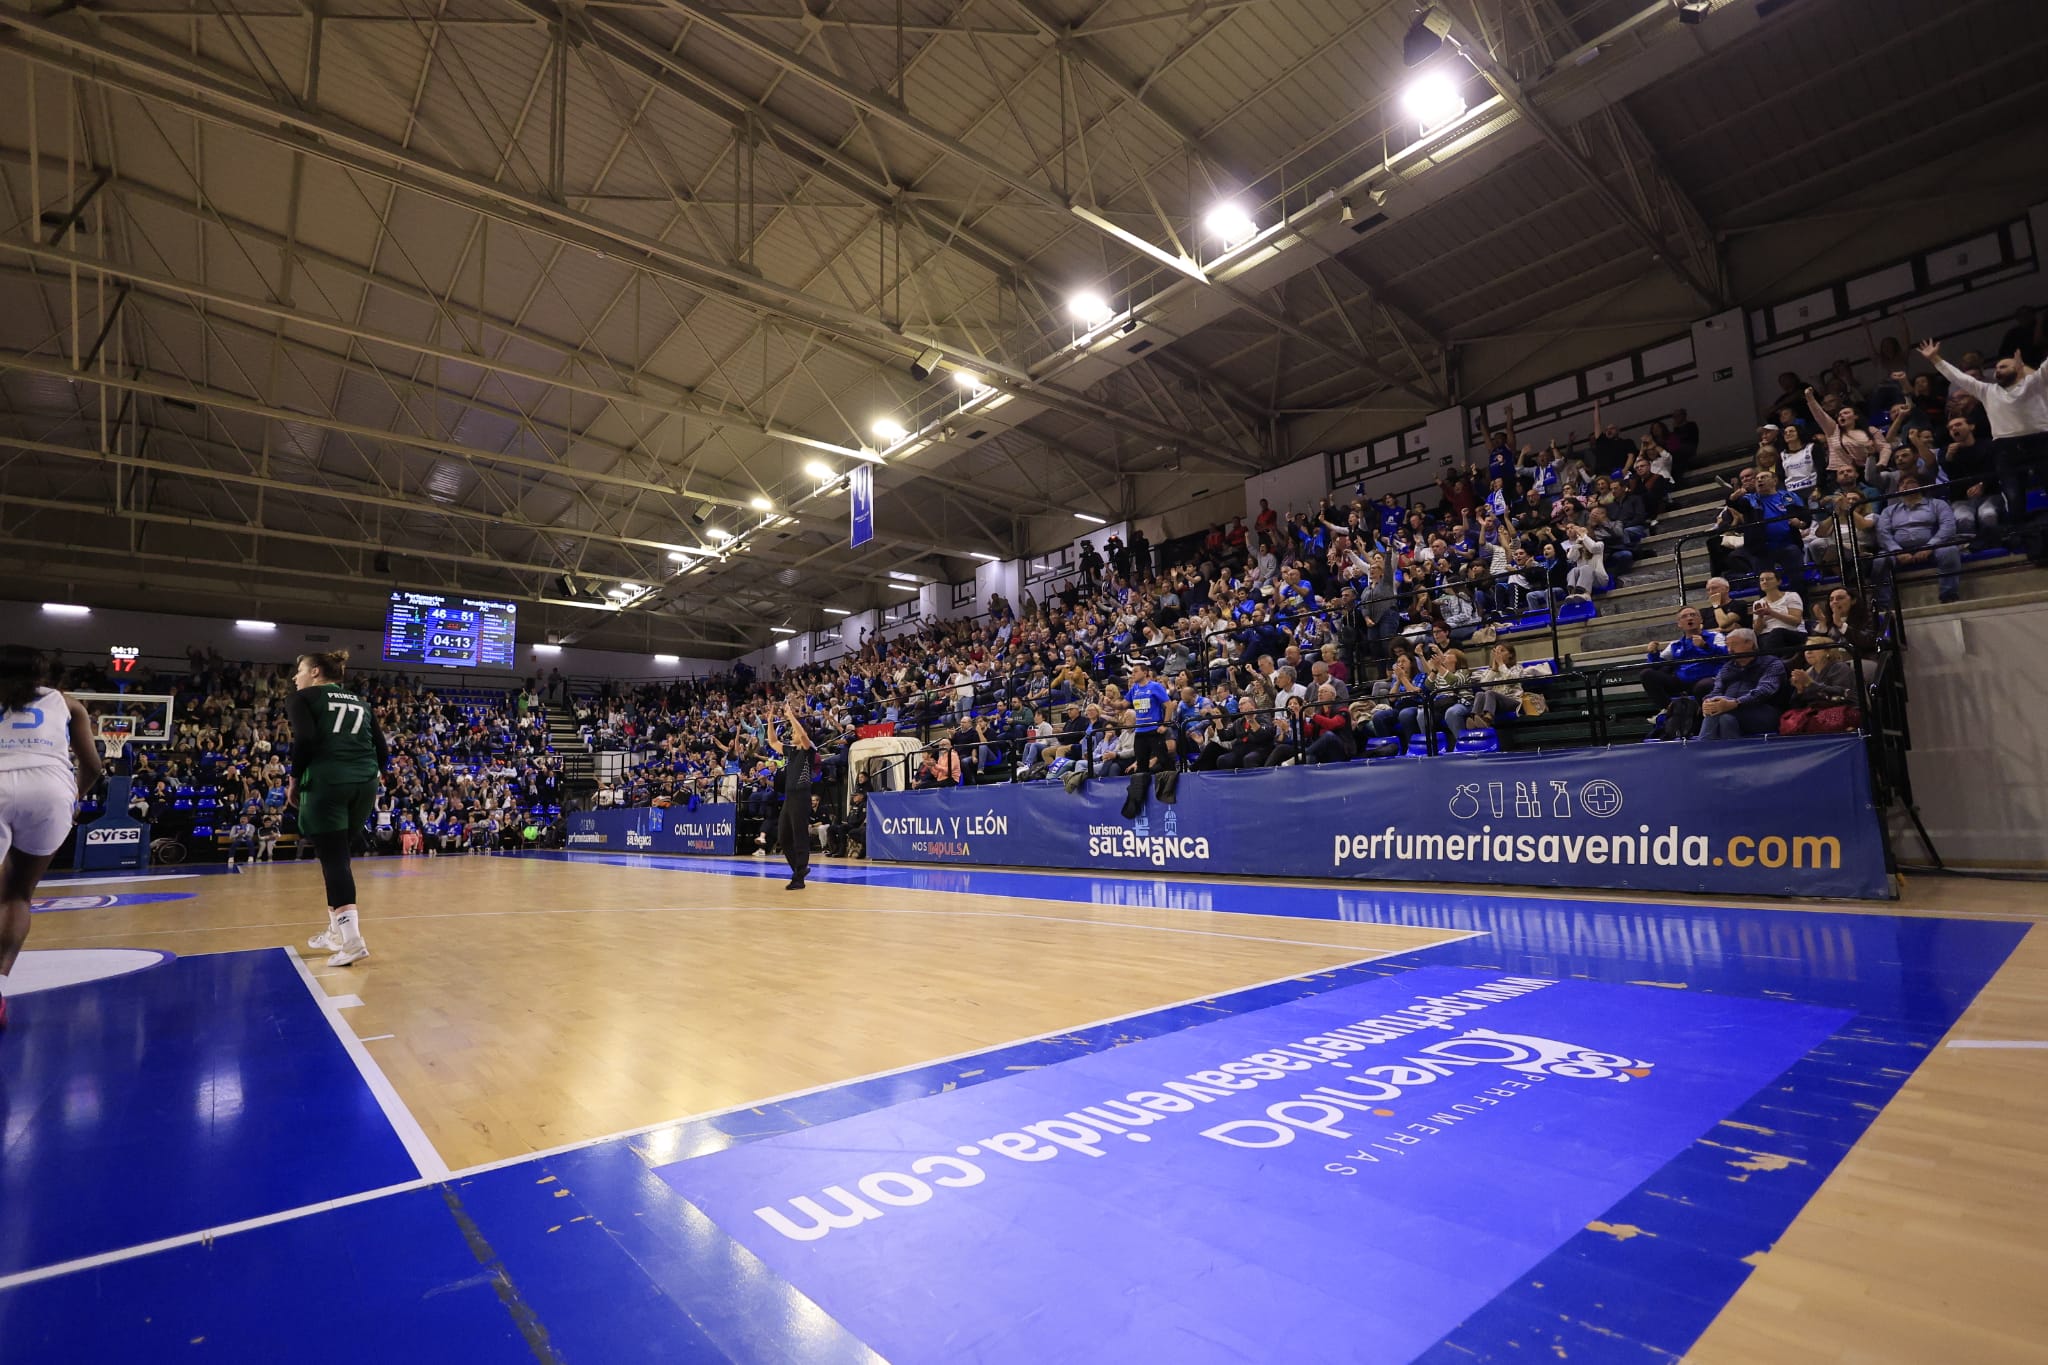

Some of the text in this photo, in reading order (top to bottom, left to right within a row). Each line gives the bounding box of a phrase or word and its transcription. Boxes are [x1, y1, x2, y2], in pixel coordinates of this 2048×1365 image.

[432, 609, 474, 621] 46 51
[433, 635, 470, 648] 04:13
[434, 649, 441, 657] 3
[112, 659, 136, 672] 17
[327, 692, 359, 702] PRINCE
[328, 702, 364, 734] 77
[674, 823, 703, 836] CASTILLA
[712, 818, 732, 836] LEÓN
[882, 809, 1008, 839] CASTILLA Y LEÓN
[1089, 824, 1123, 836] turismo
[1334, 824, 1841, 869] perfumeriasavenida.com
[753, 976, 1560, 1241] www.perfumeriasavenida.com
[1323, 1074, 1547, 1177] PERFUMERÍAS
